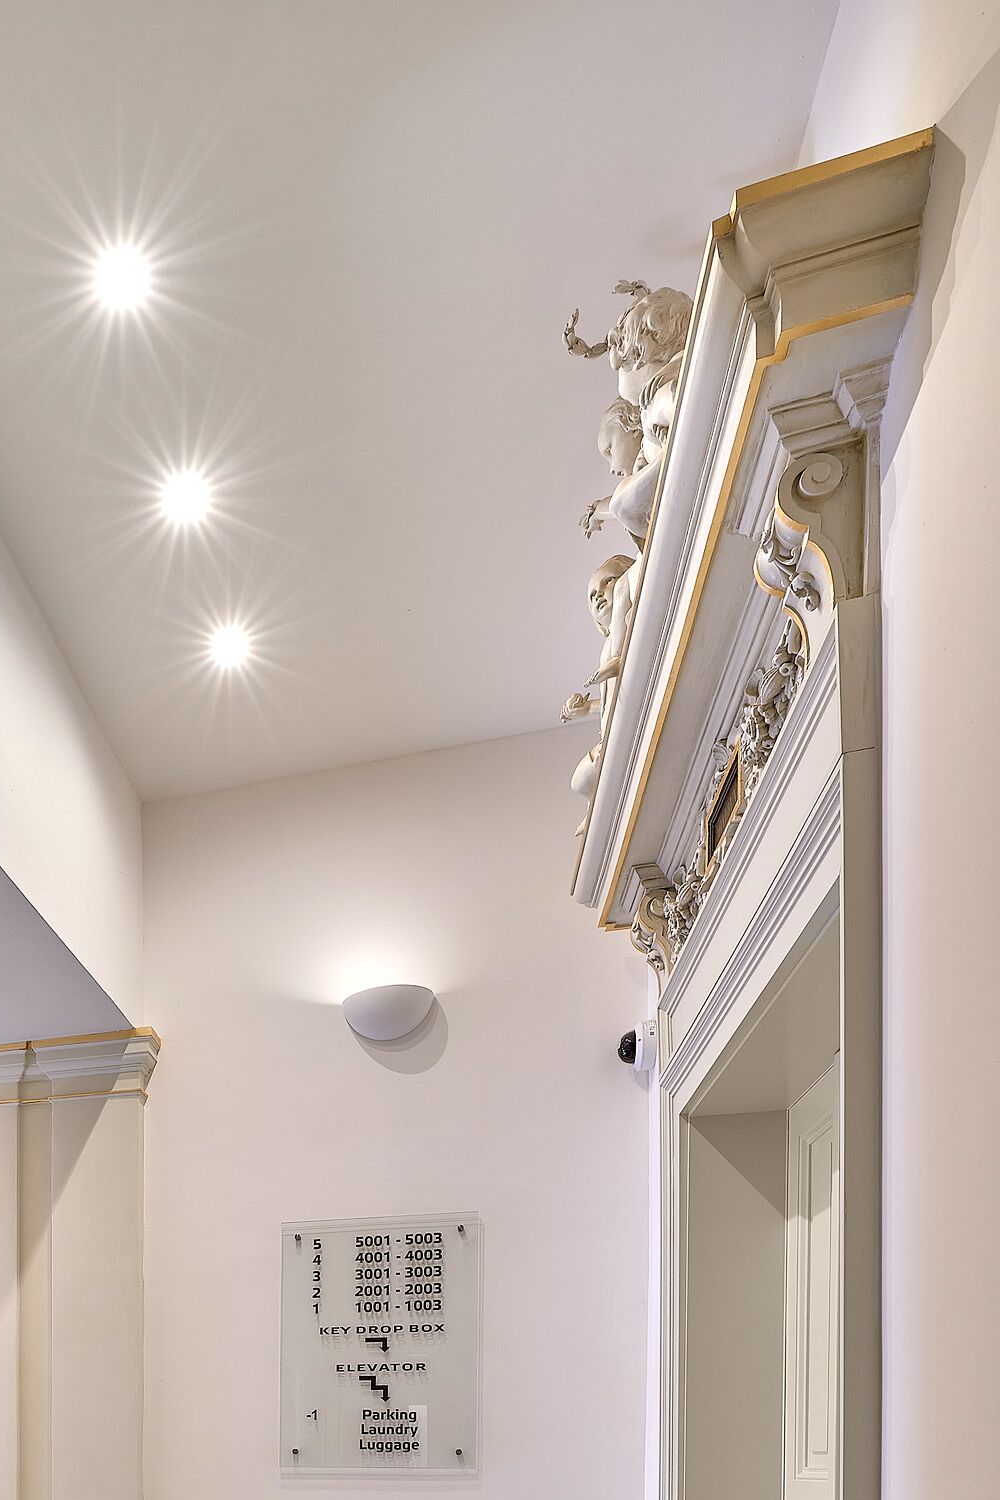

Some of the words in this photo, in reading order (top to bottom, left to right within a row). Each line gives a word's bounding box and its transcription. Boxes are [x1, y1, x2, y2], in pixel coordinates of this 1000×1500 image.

[313, 1238, 322, 1250] 5
[355, 1234, 391, 1248] 5001
[405, 1232, 443, 1245] 5003
[312, 1254, 322, 1265] 4
[355, 1251, 391, 1264] 4001
[405, 1249, 443, 1261] 4003
[312, 1270, 321, 1282] 3
[355, 1268, 391, 1280] 3001
[405, 1265, 442, 1278] 3003
[312, 1287, 321, 1299] 2
[355, 1285, 390, 1297] 2001
[405, 1282, 442, 1295] 2003
[312, 1303, 319, 1314] 1
[355, 1301, 390, 1313] 1001
[405, 1299, 442, 1311] 1003
[319, 1326, 351, 1335] KEY
[356, 1325, 404, 1334] DROP
[409, 1323, 445, 1333] BOX
[336, 1362, 427, 1372] ELEVATOR
[306, 1409, 318, 1421] -1
[362, 1408, 417, 1422] Parking
[360, 1423, 418, 1437] Laundry
[359, 1438, 420, 1452] Luggage
